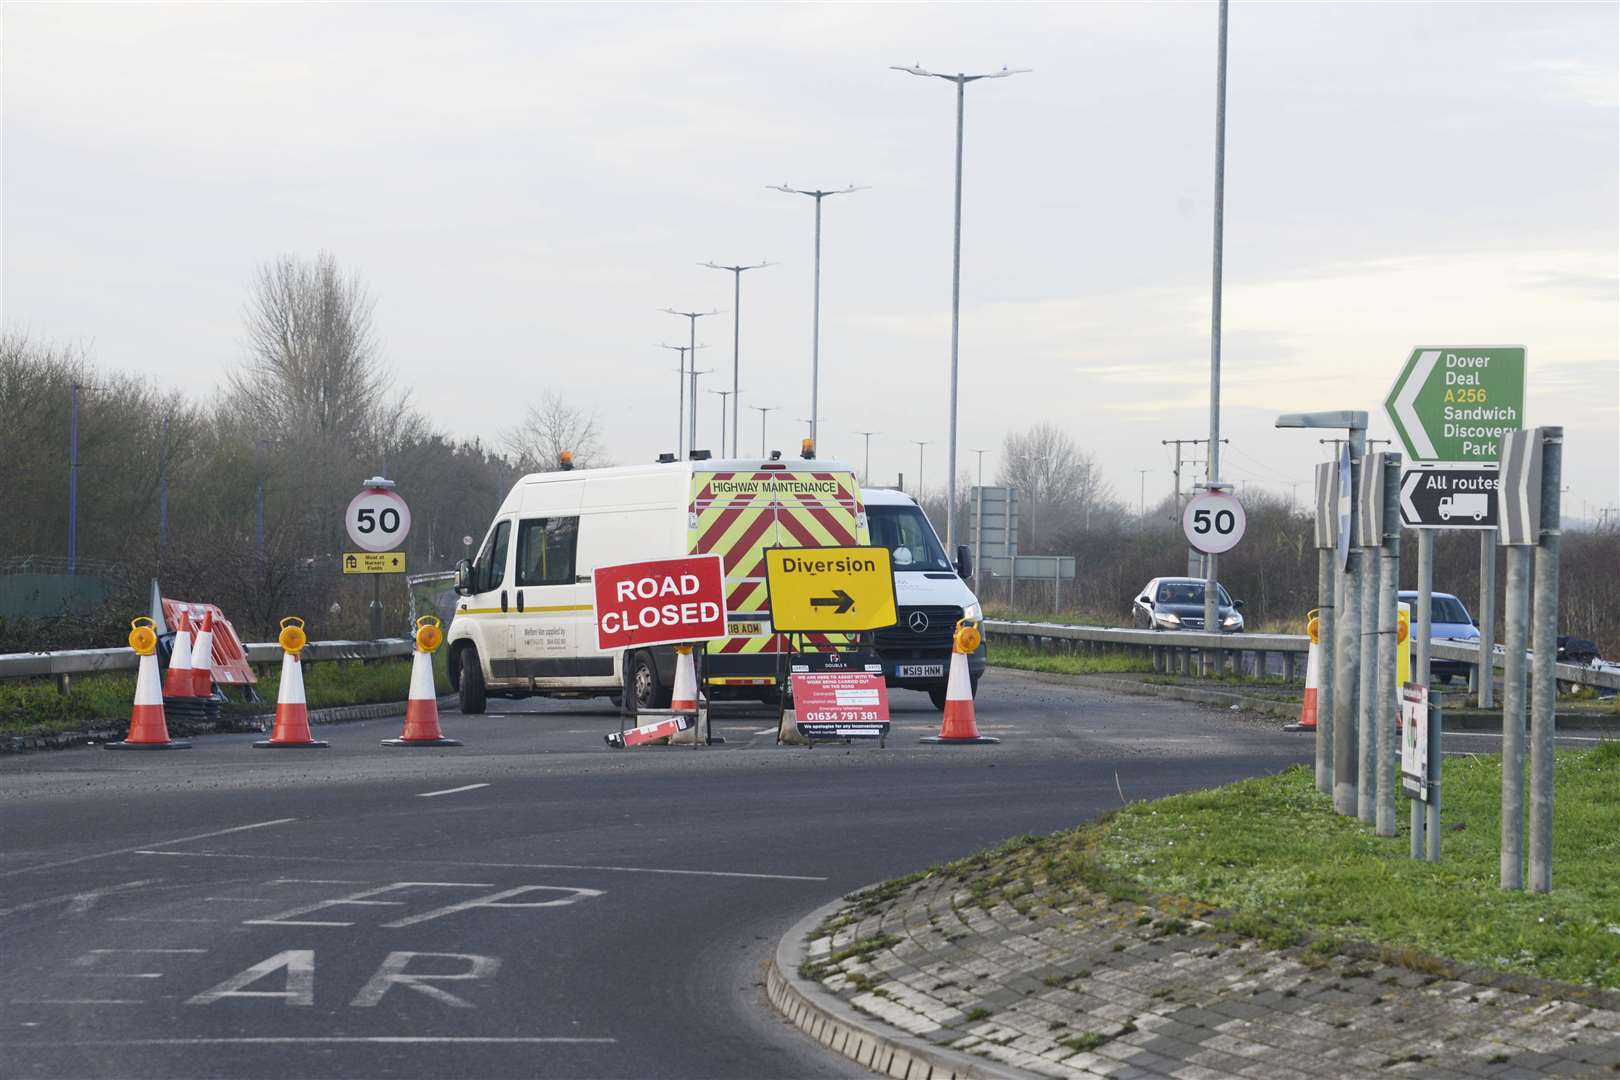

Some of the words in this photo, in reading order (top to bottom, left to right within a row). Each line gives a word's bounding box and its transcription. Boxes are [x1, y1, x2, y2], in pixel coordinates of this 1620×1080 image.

[1446, 354, 1490, 368] Dover
[1445, 371, 1480, 385] Deal
[1443, 406, 1516, 420] Sandwich
[1462, 441, 1497, 455] Park
[713, 482, 759, 493] HIGHWAY
[762, 482, 836, 493] MAINTENANCE
[1426, 475, 1447, 489] All
[1452, 475, 1499, 490] routes
[357, 507, 400, 534] 50
[1193, 509, 1235, 535] 50
[782, 557, 875, 573] Diversion
[616, 574, 700, 603] ROAD
[601, 601, 720, 634] CLOSED
[807, 712, 838, 720] 01634
[840, 712, 858, 720] 791
[861, 712, 877, 720] 381
